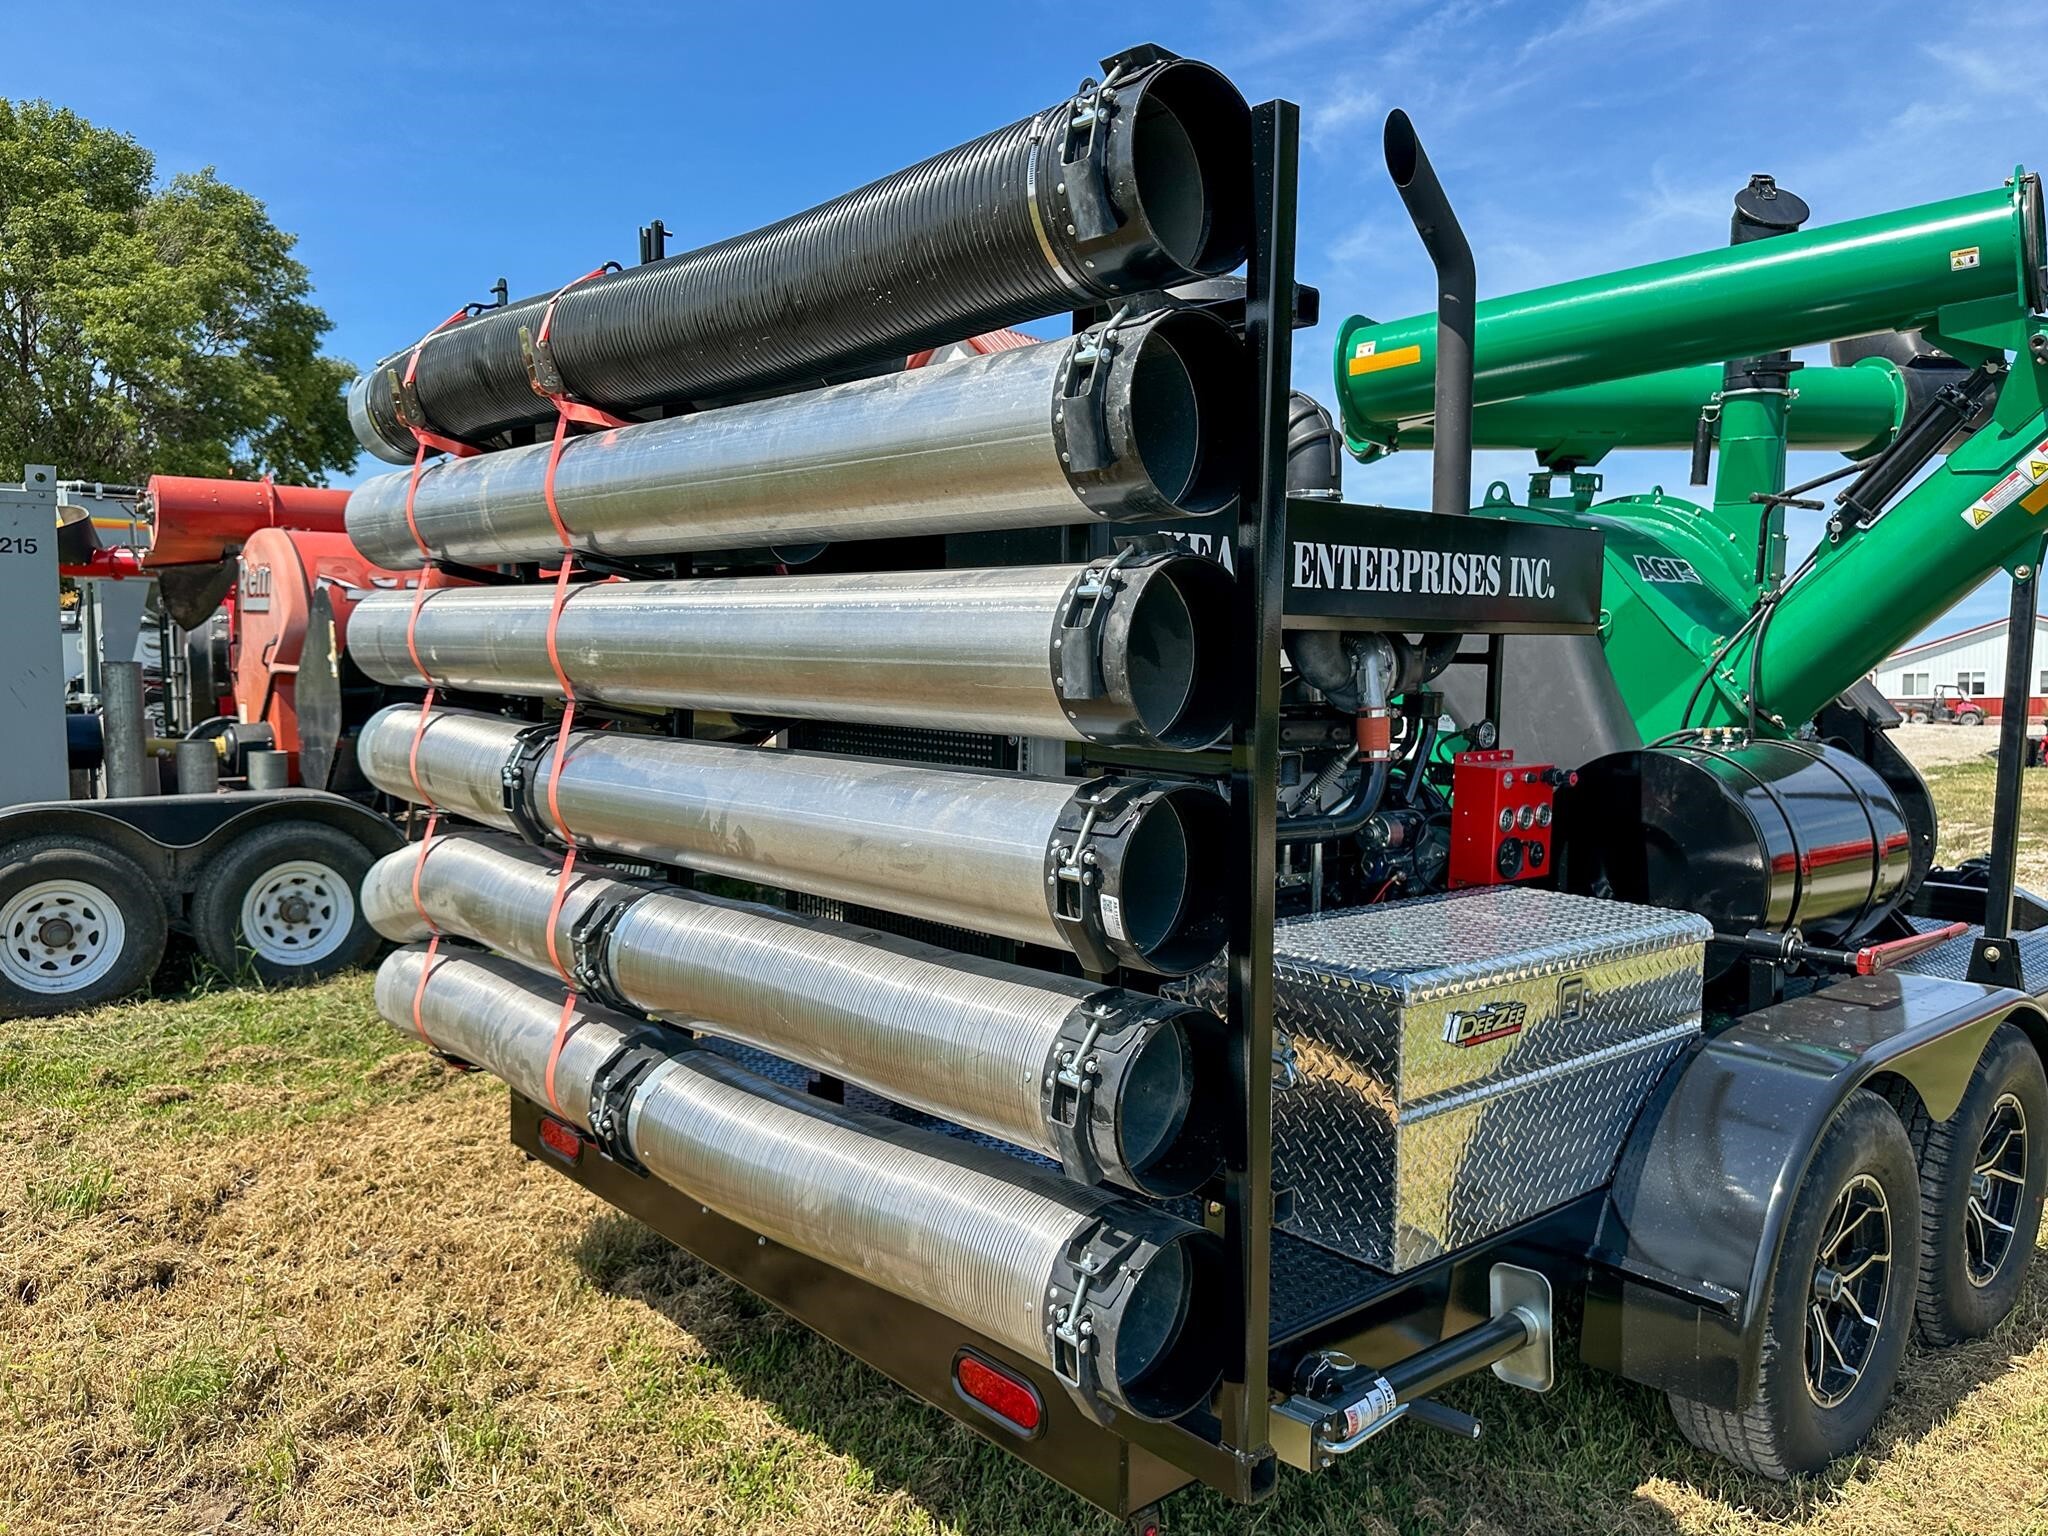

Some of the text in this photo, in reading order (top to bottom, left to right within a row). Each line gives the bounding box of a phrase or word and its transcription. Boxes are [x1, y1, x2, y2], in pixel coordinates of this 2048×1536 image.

[0, 537, 38, 555] 215
[1292, 541, 1501, 598] ENTERPRISES
[1508, 557, 1555, 599] INC.
[1633, 554, 1686, 583] AGI
